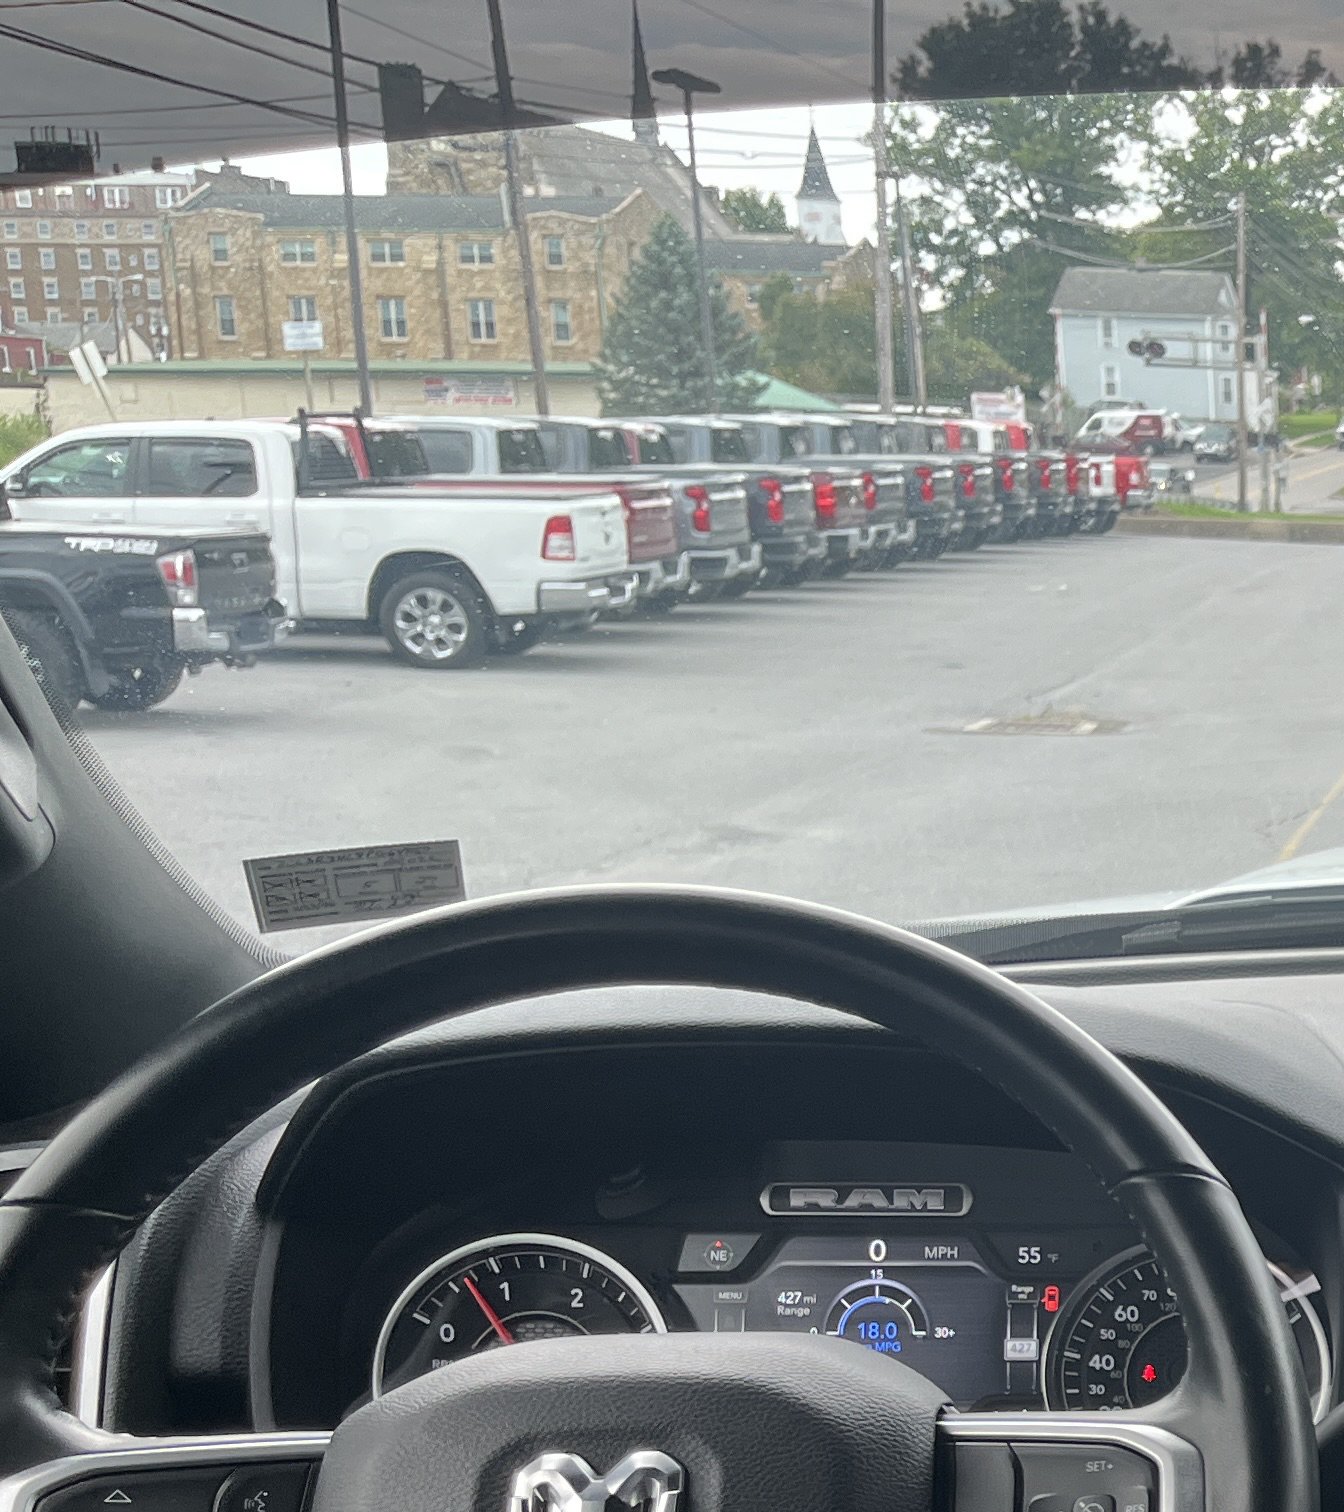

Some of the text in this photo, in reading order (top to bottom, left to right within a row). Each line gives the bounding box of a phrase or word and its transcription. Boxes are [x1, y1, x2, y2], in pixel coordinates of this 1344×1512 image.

[789, 1188, 945, 1210] RAM
[710, 1249, 728, 1261] NE
[869, 1239, 959, 1263] 0 MPH
[1018, 1246, 1041, 1264] 55
[870, 1269, 884, 1280] 15
[500, 1281, 511, 1302] 1
[570, 1288, 585, 1309] 2
[777, 1291, 817, 1305] 427 mi
[1141, 1289, 1158, 1302] 70
[777, 1305, 811, 1318] Range
[1114, 1305, 1139, 1323] 60
[439, 1323, 456, 1343] 0
[857, 1321, 898, 1340] 18.0
[934, 1327, 956, 1339] 30+
[1100, 1329, 1116, 1341] 50
[1088, 1354, 1116, 1371] 40
[1088, 1384, 1106, 1395] 30
